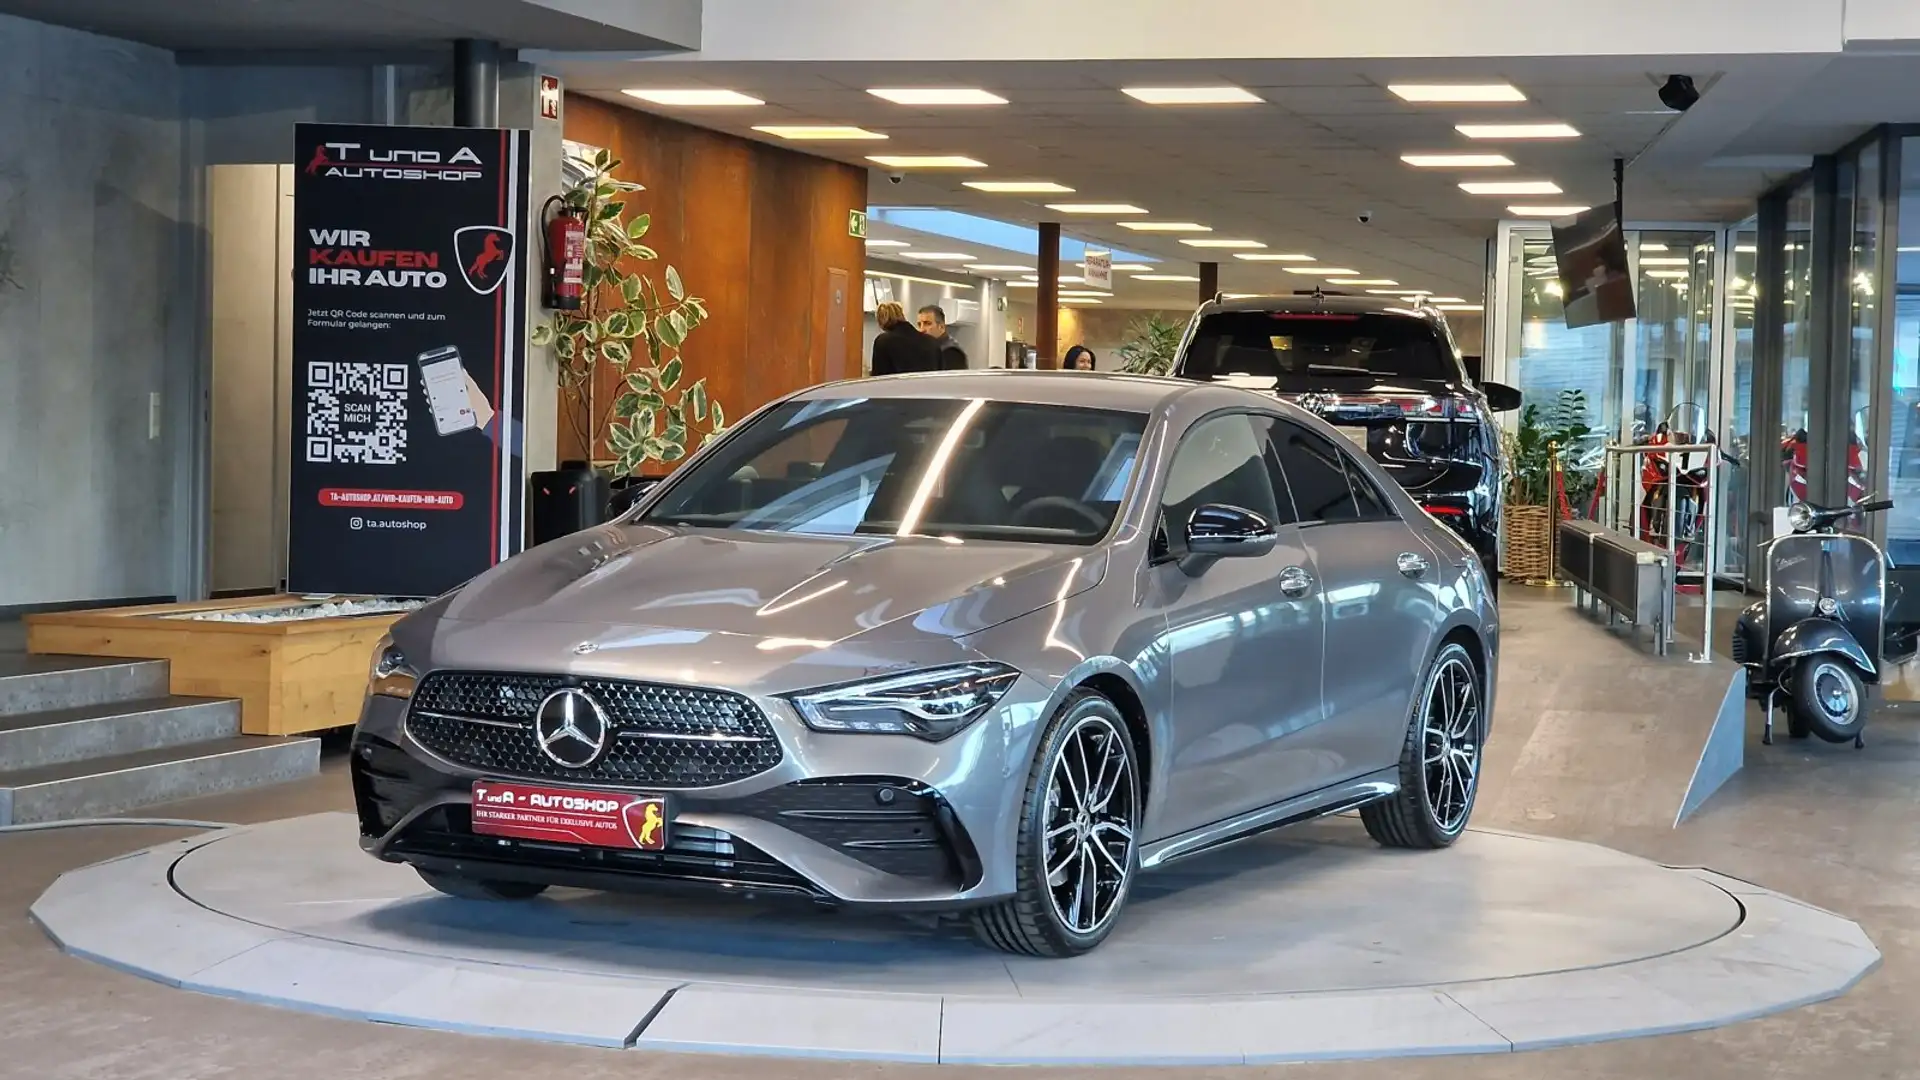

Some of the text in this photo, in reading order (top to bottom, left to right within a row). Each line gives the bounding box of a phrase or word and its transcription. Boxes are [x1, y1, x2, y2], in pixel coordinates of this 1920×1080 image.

[325, 142, 361, 160] T
[448, 146, 483, 165] A
[325, 166, 482, 181] AUTOSHOP
[309, 228, 370, 246] WIR
[309, 247, 438, 269] KAUFEN
[308, 267, 447, 288] IHR AUTO
[307, 308, 446, 321] Jetzt QR Code scannen und zum
[307, 319, 391, 330] Formular gelangen:
[344, 403, 371, 412] SCAN
[344, 413, 371, 423] MICH
[366, 519, 427, 531] ta.autoshop
[530, 793, 619, 812] AUTOSHOP
[476, 810, 488, 818] IHR
[488, 811, 515, 821] STARKER
[516, 814, 545, 824] PARTNER
[594, 820, 618, 830] AUTOS
